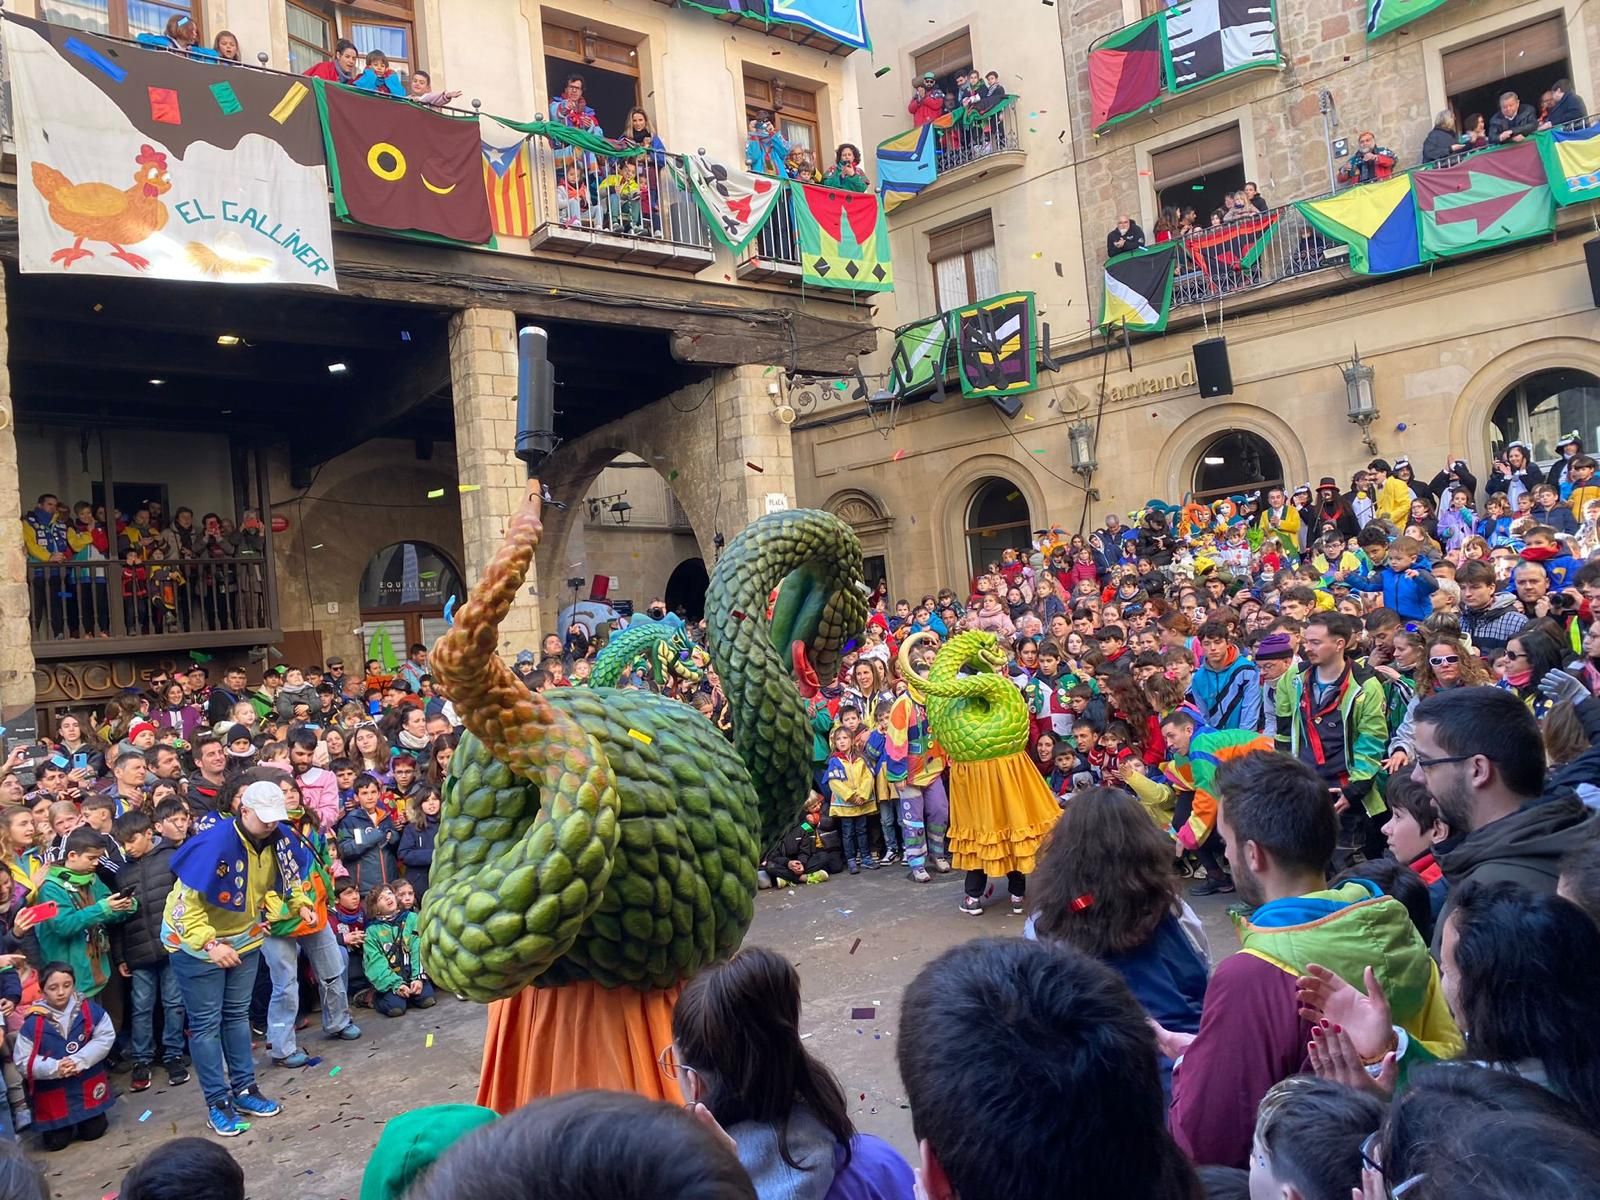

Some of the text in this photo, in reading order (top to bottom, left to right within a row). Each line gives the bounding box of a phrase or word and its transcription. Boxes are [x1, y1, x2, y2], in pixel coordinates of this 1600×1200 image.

[175, 198, 330, 276] EL GALLINER
[1095, 360, 1197, 406] Santand
